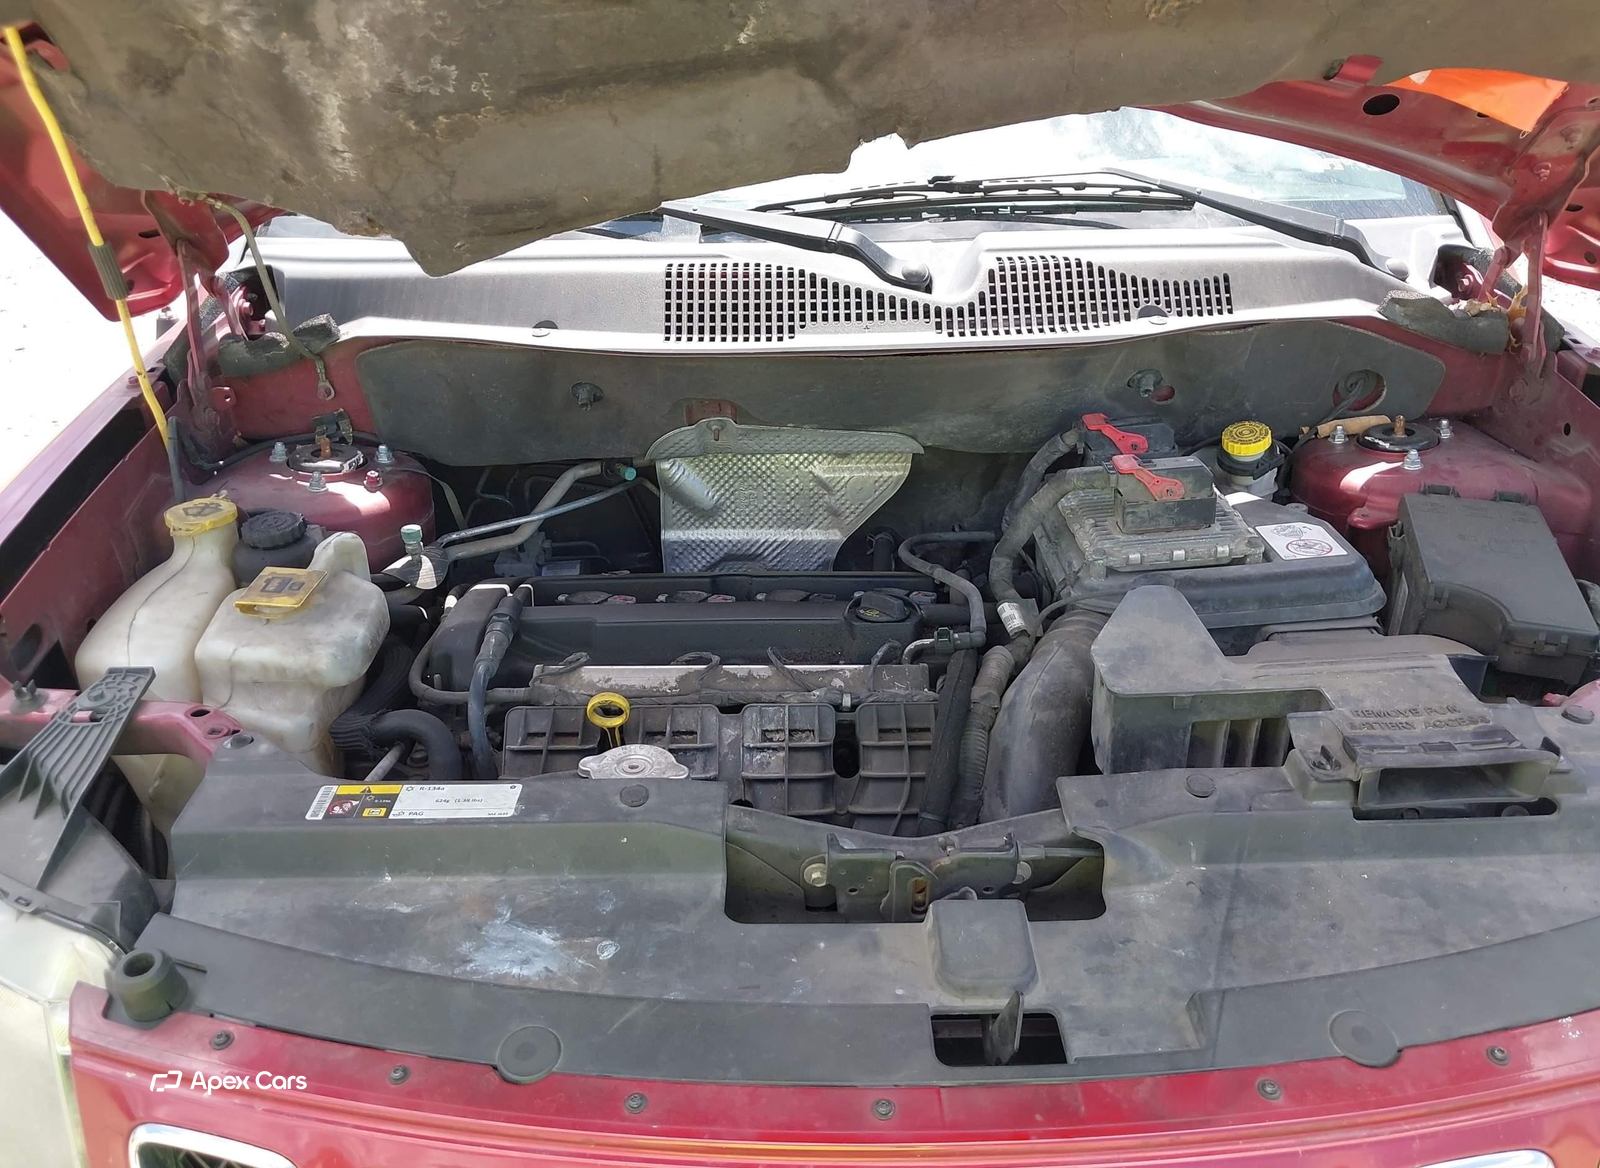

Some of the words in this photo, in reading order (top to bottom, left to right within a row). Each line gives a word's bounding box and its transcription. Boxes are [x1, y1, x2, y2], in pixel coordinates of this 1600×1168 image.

[1350, 707, 1424, 719] REMOVE
[1424, 705, 1461, 717] FOR
[1348, 721, 1417, 731] BATTERY
[1424, 715, 1491, 729] ACCESS
